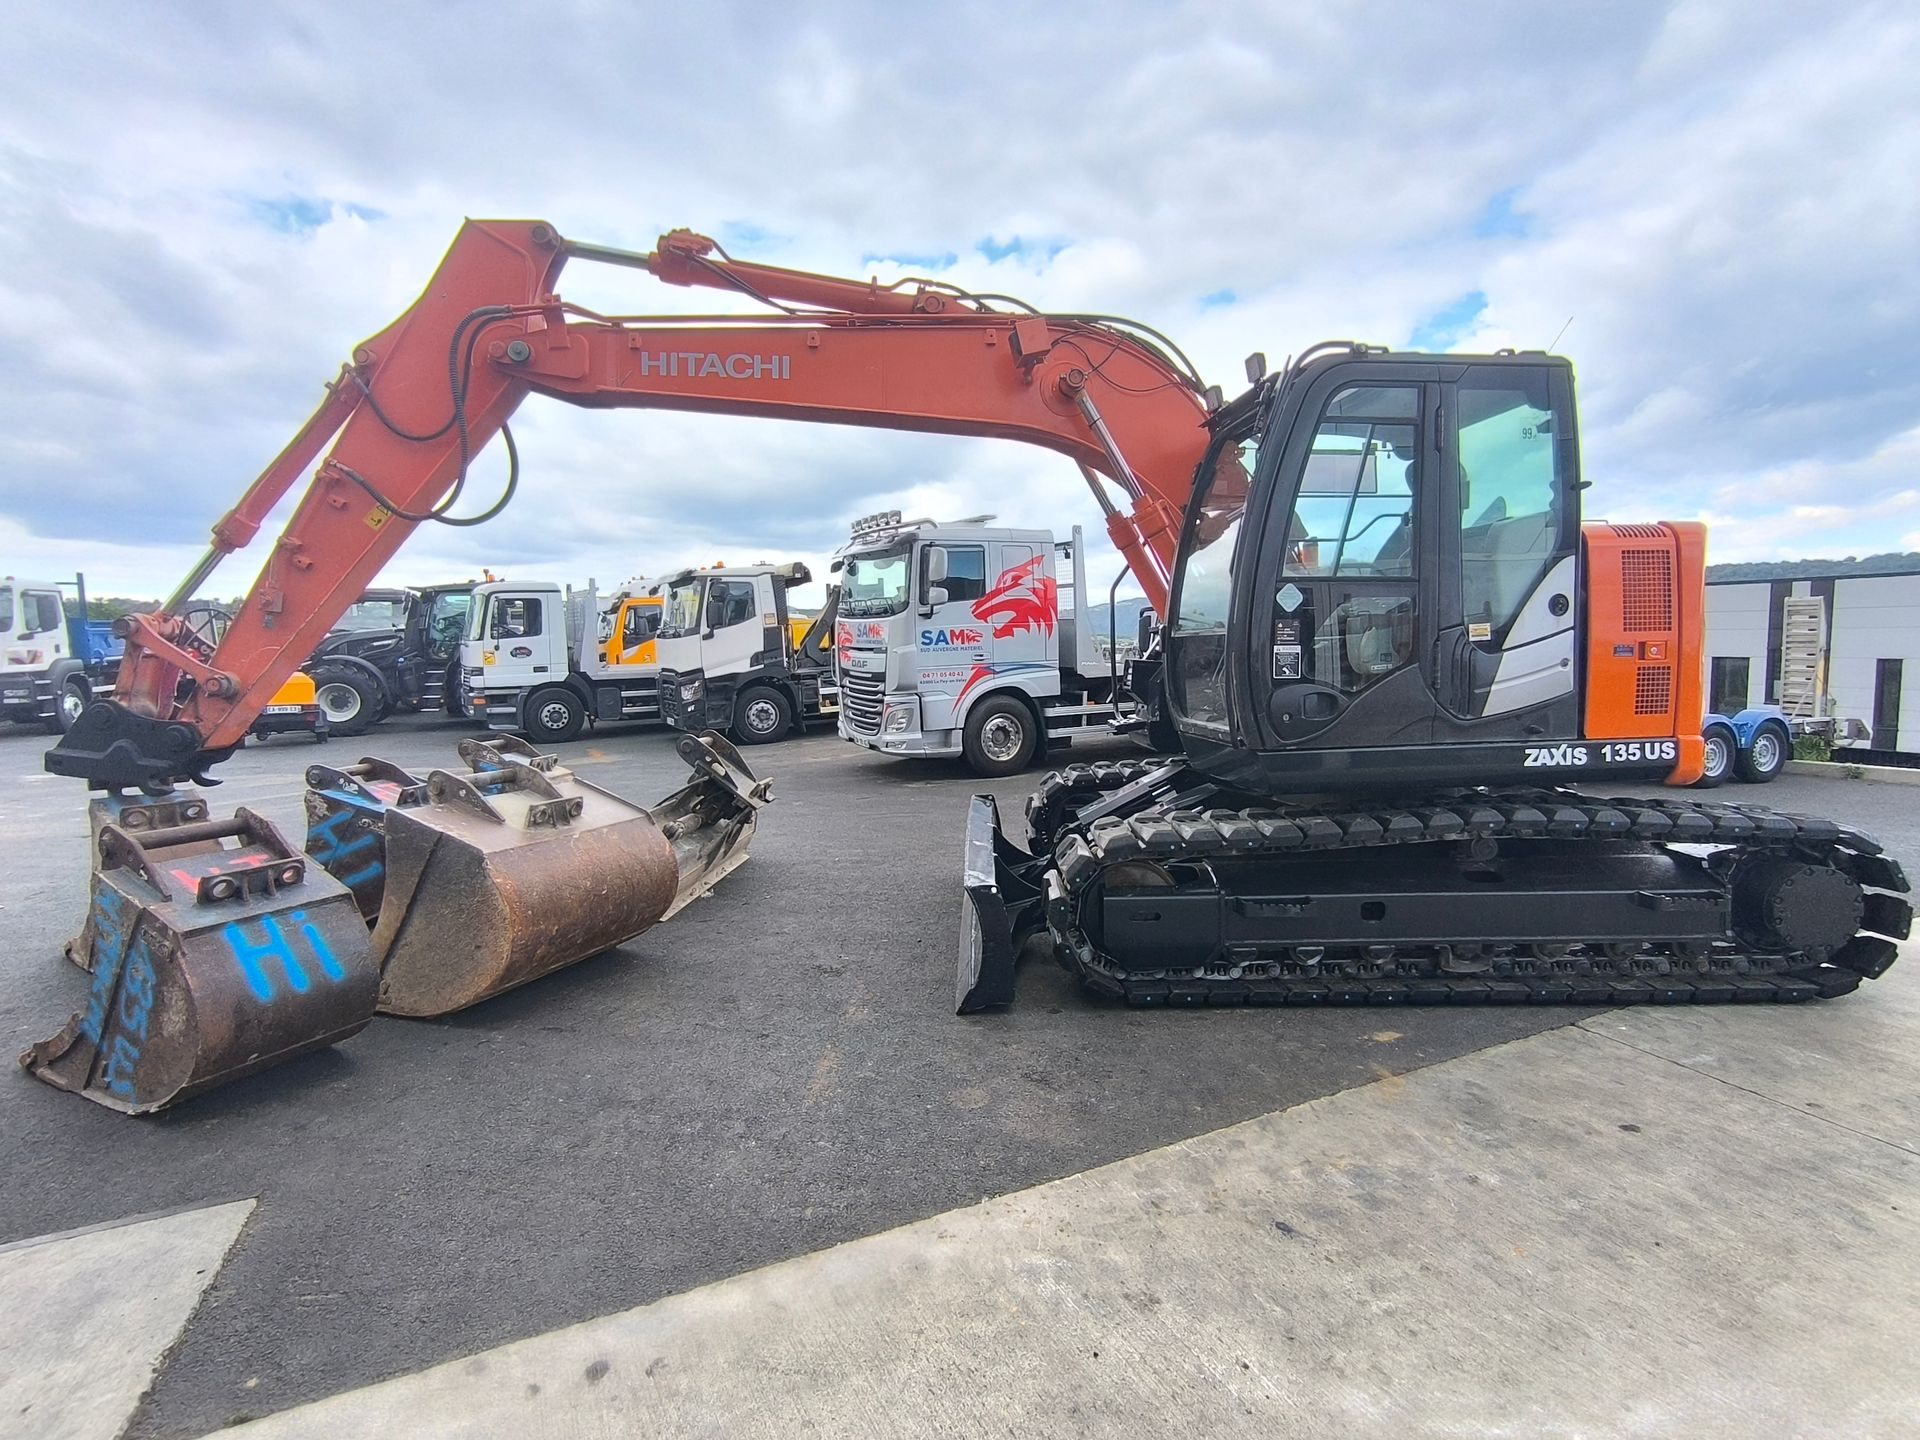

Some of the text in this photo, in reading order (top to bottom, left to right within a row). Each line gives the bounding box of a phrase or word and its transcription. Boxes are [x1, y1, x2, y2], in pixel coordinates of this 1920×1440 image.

[640, 351, 790, 380] HITACHI
[920, 629, 965, 646] SAM
[851, 659, 868, 669] DAF
[1523, 743, 1588, 767] ZAXIS
[223, 908, 345, 1004] Hi
